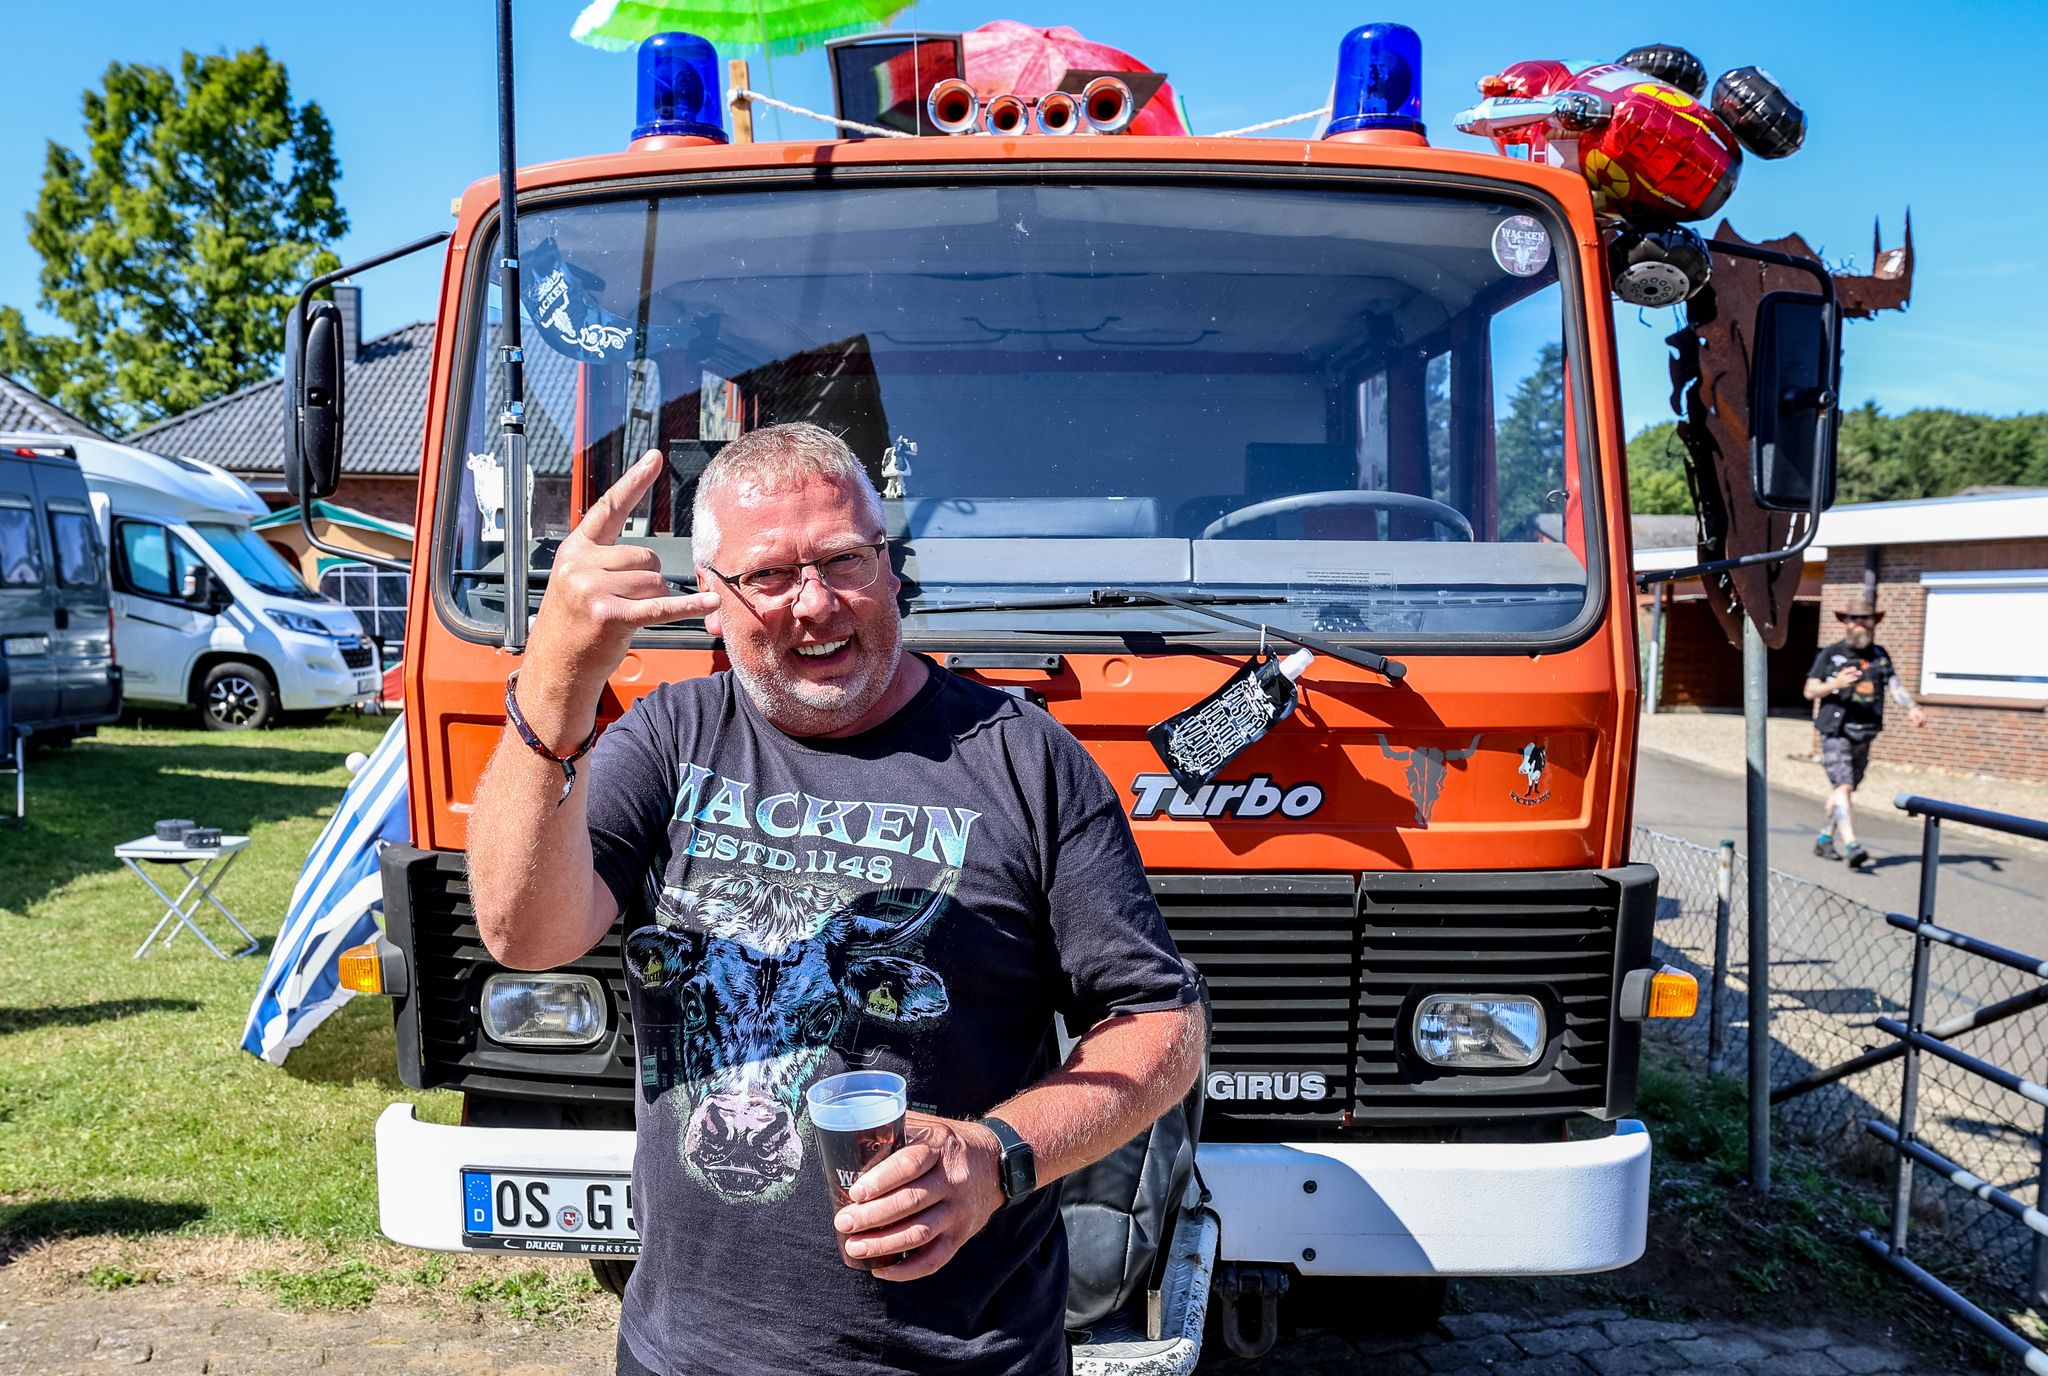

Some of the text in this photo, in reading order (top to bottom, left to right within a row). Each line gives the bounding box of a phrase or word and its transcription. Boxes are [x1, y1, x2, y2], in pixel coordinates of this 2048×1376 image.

[1501, 227, 1546, 242] WACKEN
[1200, 699, 1246, 759] HARDER
[1221, 680, 1267, 738] FASTER
[1173, 716, 1223, 776] WATER
[1131, 774, 1325, 819] Turbo
[1205, 1072, 1327, 1101] GIRUS
[474, 1208, 485, 1222] D
[496, 1180, 550, 1228] OS
[586, 1184, 613, 1230] G
[525, 1240, 644, 1254] DÄLKEN WERKSTAT
